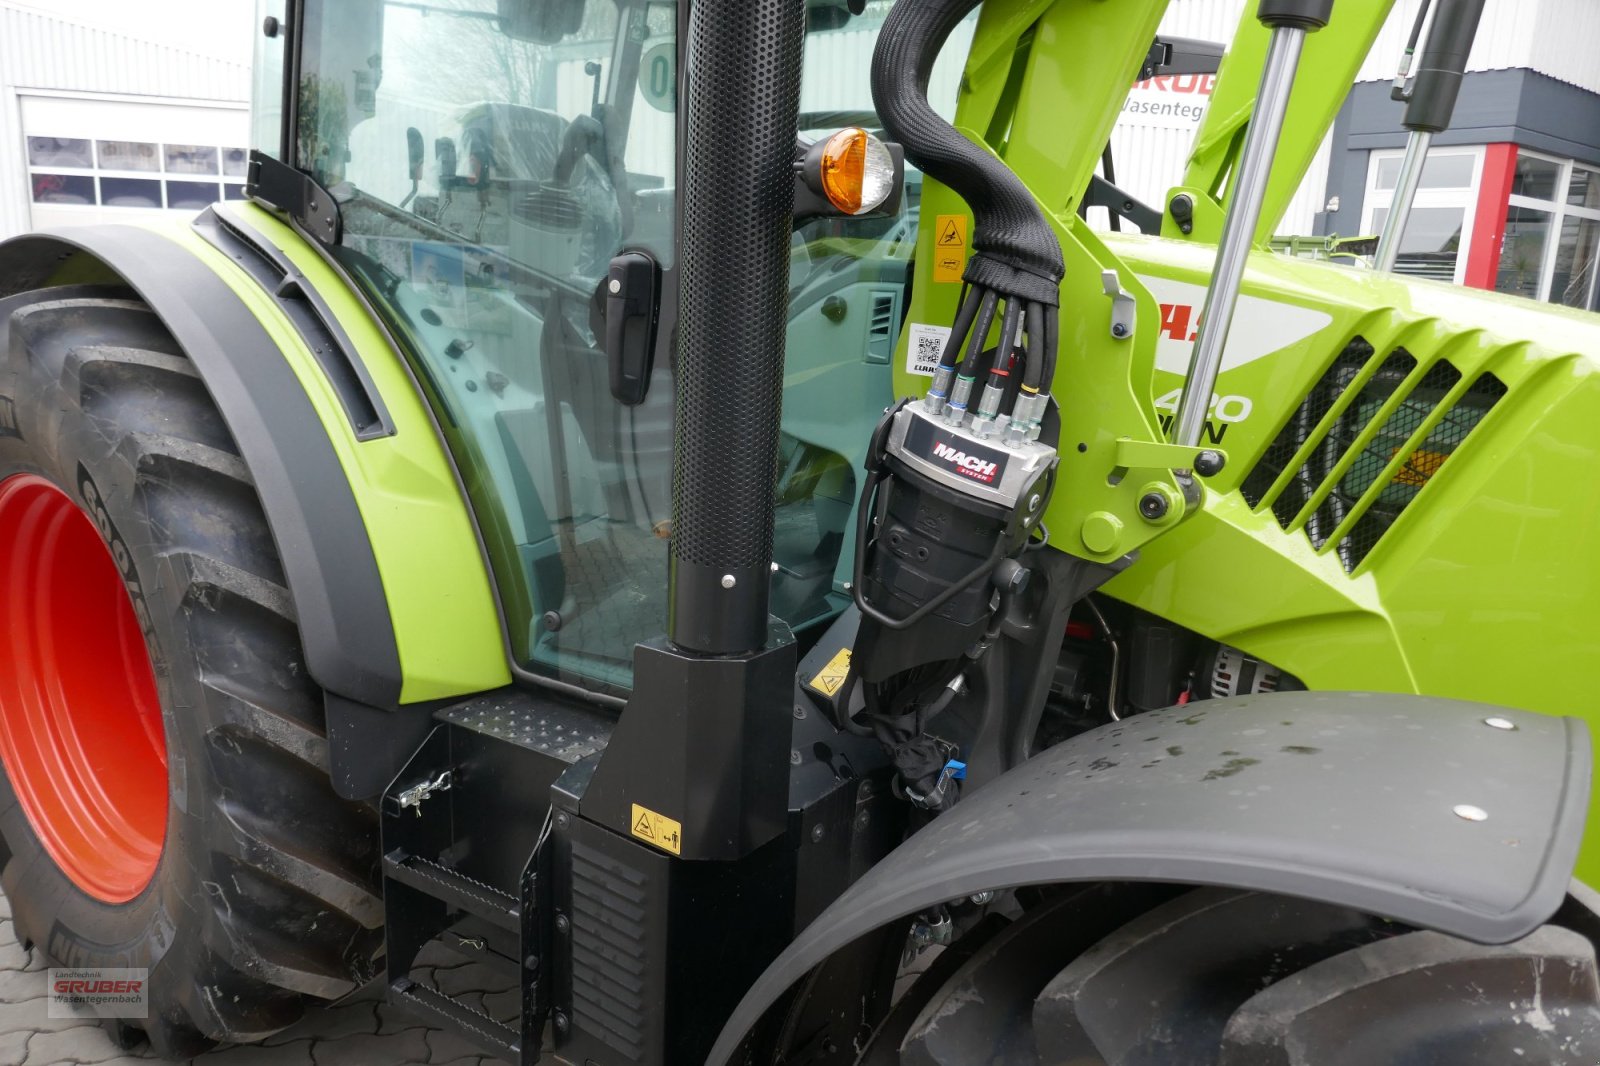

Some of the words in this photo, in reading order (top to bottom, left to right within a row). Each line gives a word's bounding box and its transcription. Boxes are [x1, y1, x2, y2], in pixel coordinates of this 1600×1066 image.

[650, 55, 669, 98] 0
[914, 364, 936, 373] CLAA
[933, 442, 997, 476] MACH
[961, 468, 988, 481] SYSTEM
